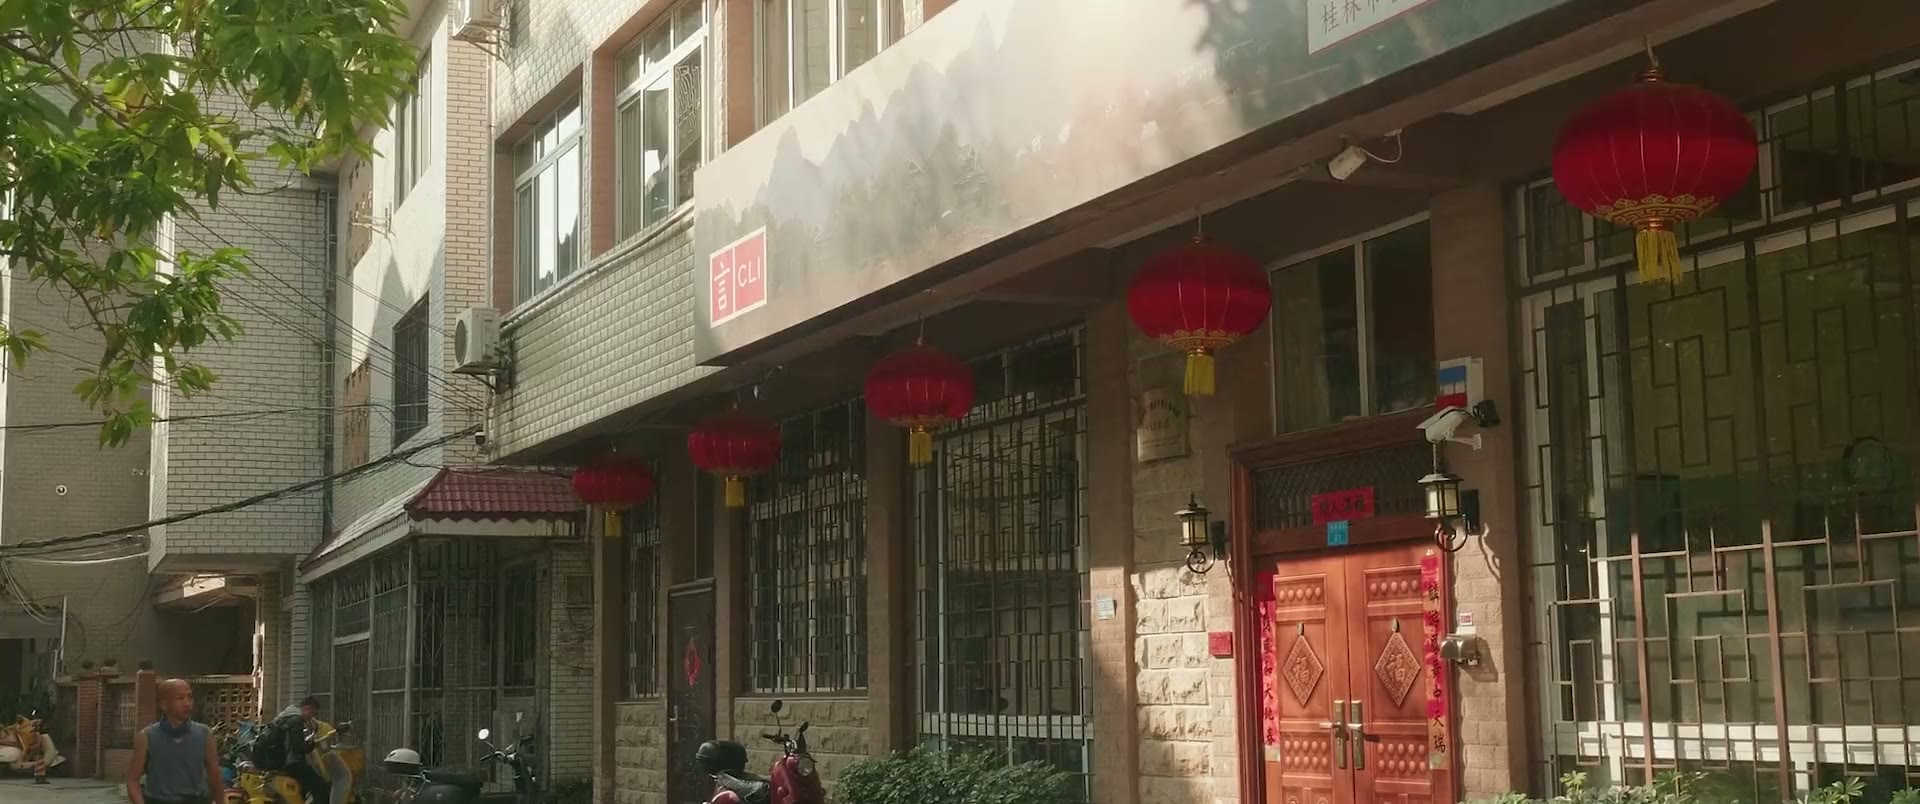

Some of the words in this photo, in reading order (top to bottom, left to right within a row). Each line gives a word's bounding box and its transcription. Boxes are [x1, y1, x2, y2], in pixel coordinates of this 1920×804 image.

[714, 261, 731, 310] 言
[738, 256, 760, 287] CLI
[1292, 655, 1311, 685] 福
[1386, 653, 1406, 684] 福
